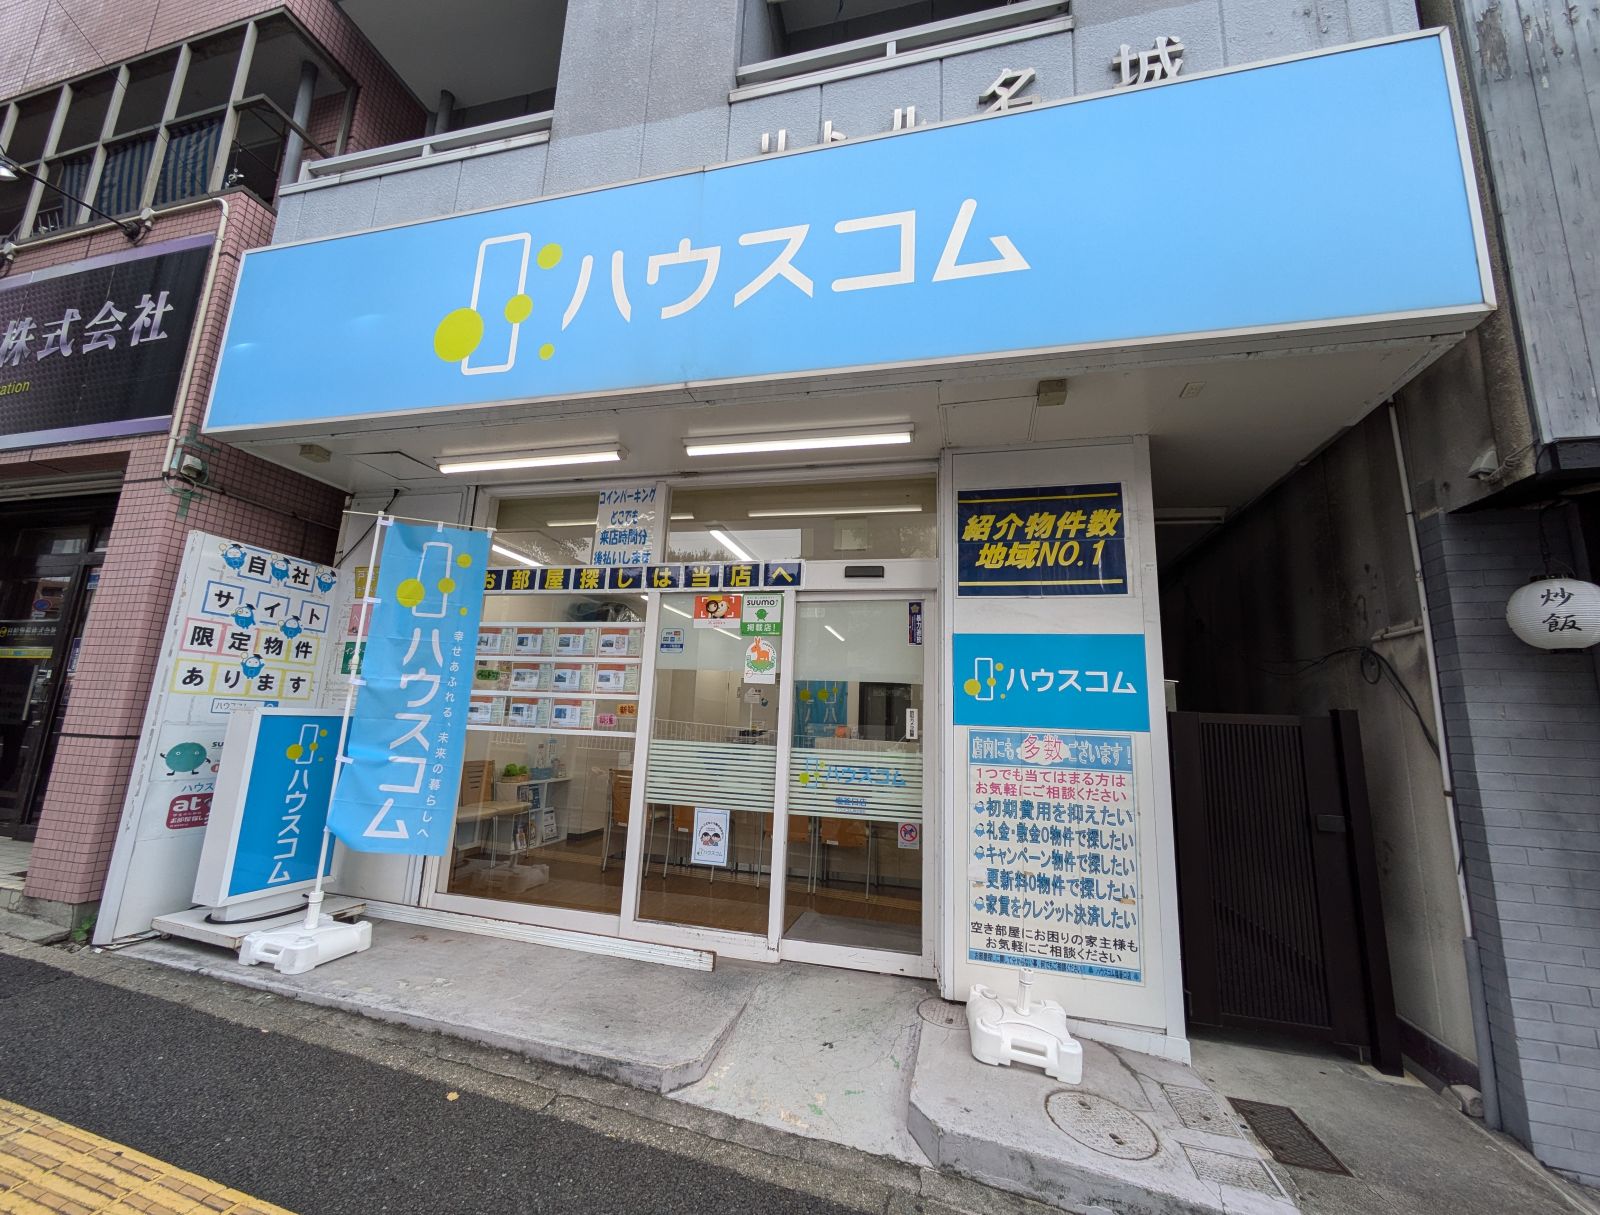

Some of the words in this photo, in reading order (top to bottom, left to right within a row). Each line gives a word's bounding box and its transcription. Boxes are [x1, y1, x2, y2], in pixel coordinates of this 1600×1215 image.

[561, 198, 1032, 331] ハウスコム
[0, 381, 30, 396] ation
[600, 529, 648, 545] 来店時間分
[962, 509, 1122, 541] 紹介物件数
[247, 556, 310, 586] 自社
[594, 550, 651, 565] 後払いします
[485, 563, 793, 590] お部屋探しは当店へ
[214, 590, 320, 624] サイト
[1540, 587, 1582, 632] 炒飯
[190, 625, 313, 659] 限定物件
[182, 667, 306, 693] あります
[1007, 668, 1137, 694] ハウスコム
[362, 627, 444, 839] ハウスコム
[416, 630, 464, 838] 幸せあふれる、未来の暮らしへ
[181, 782, 214, 792] ハウス
[826, 766, 906, 785] ハウスコム
[976, 768, 1126, 787] 1つでも当てはまる方は
[975, 781, 1127, 803] お気軽にご相談ください
[267, 769, 310, 883] ハウスコム
[986, 798, 1134, 827] 初期費用を抑えたい
[985, 843, 1136, 877] キャンペーン物件で探したい
[985, 894, 1137, 930] 家賃をクレジット決済したい
[970, 921, 1139, 953] 空き部屋にお困りの家主様も
[985, 937, 1122, 964] お気軽にご相談ください
